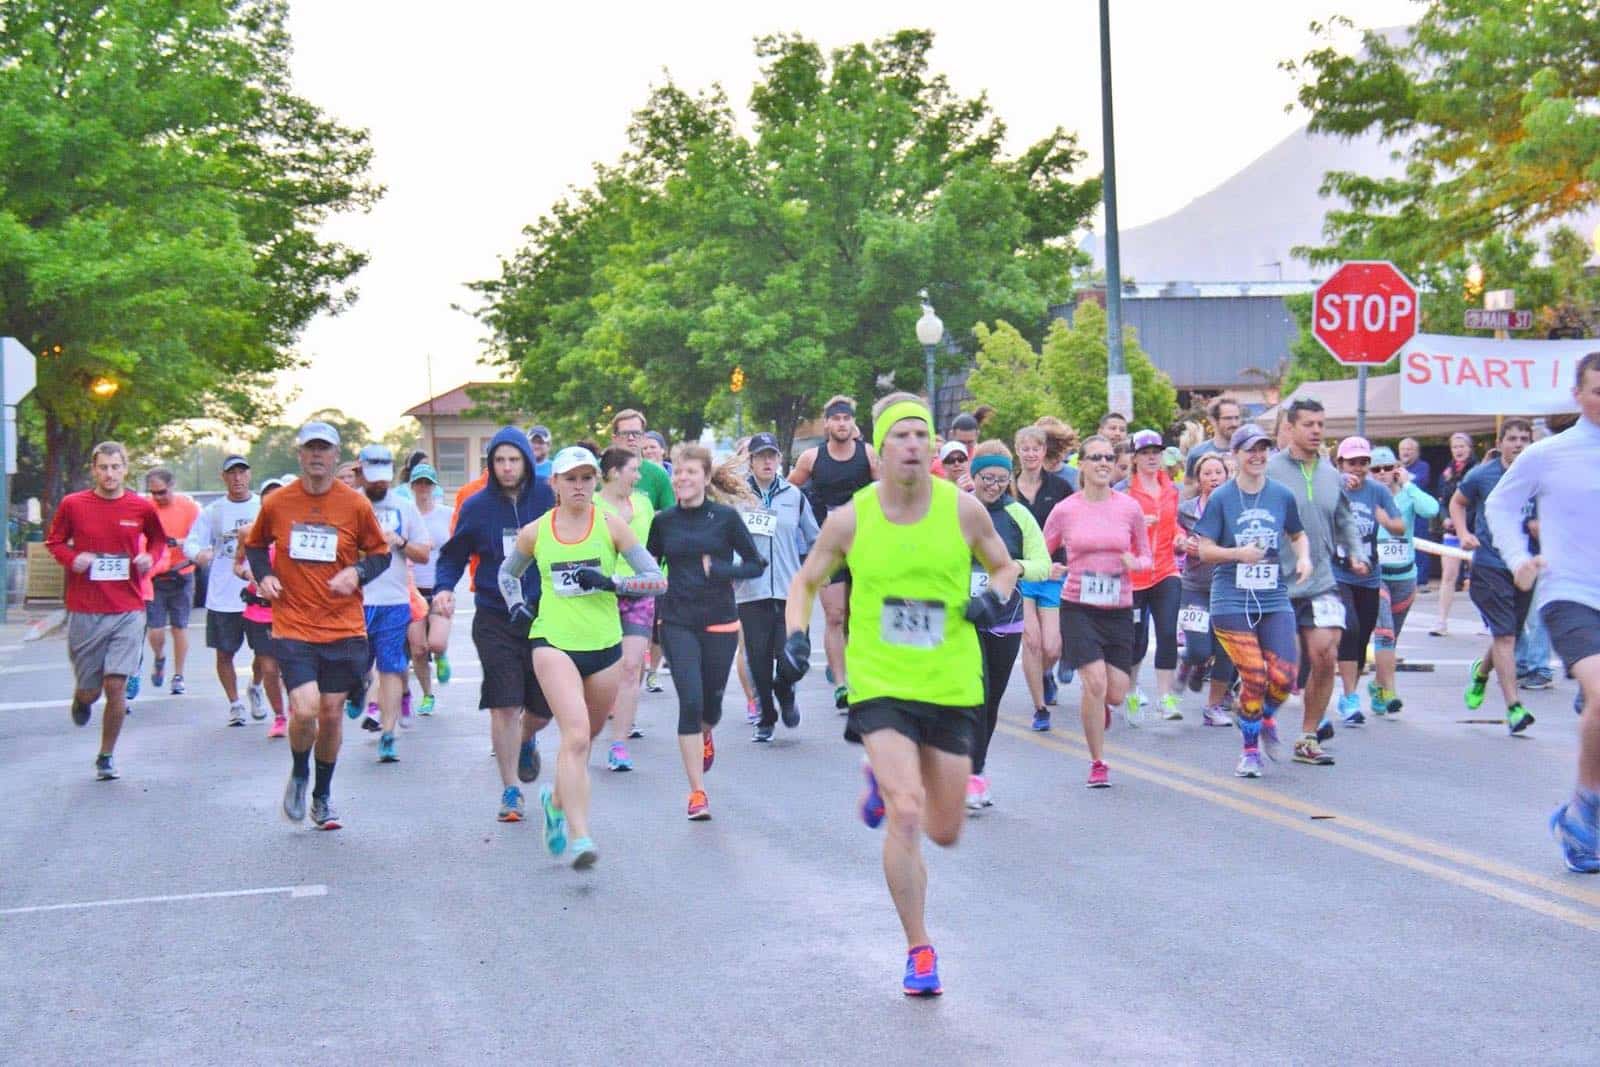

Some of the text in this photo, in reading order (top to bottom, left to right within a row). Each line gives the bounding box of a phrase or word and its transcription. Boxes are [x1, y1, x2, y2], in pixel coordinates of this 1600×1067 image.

[1320, 293, 1412, 332] STOP
[1407, 352, 1535, 389] START
[748, 513, 770, 526] 267
[299, 534, 328, 549] 277
[1245, 566, 1271, 578] 215
[1183, 611, 1203, 622] 207
